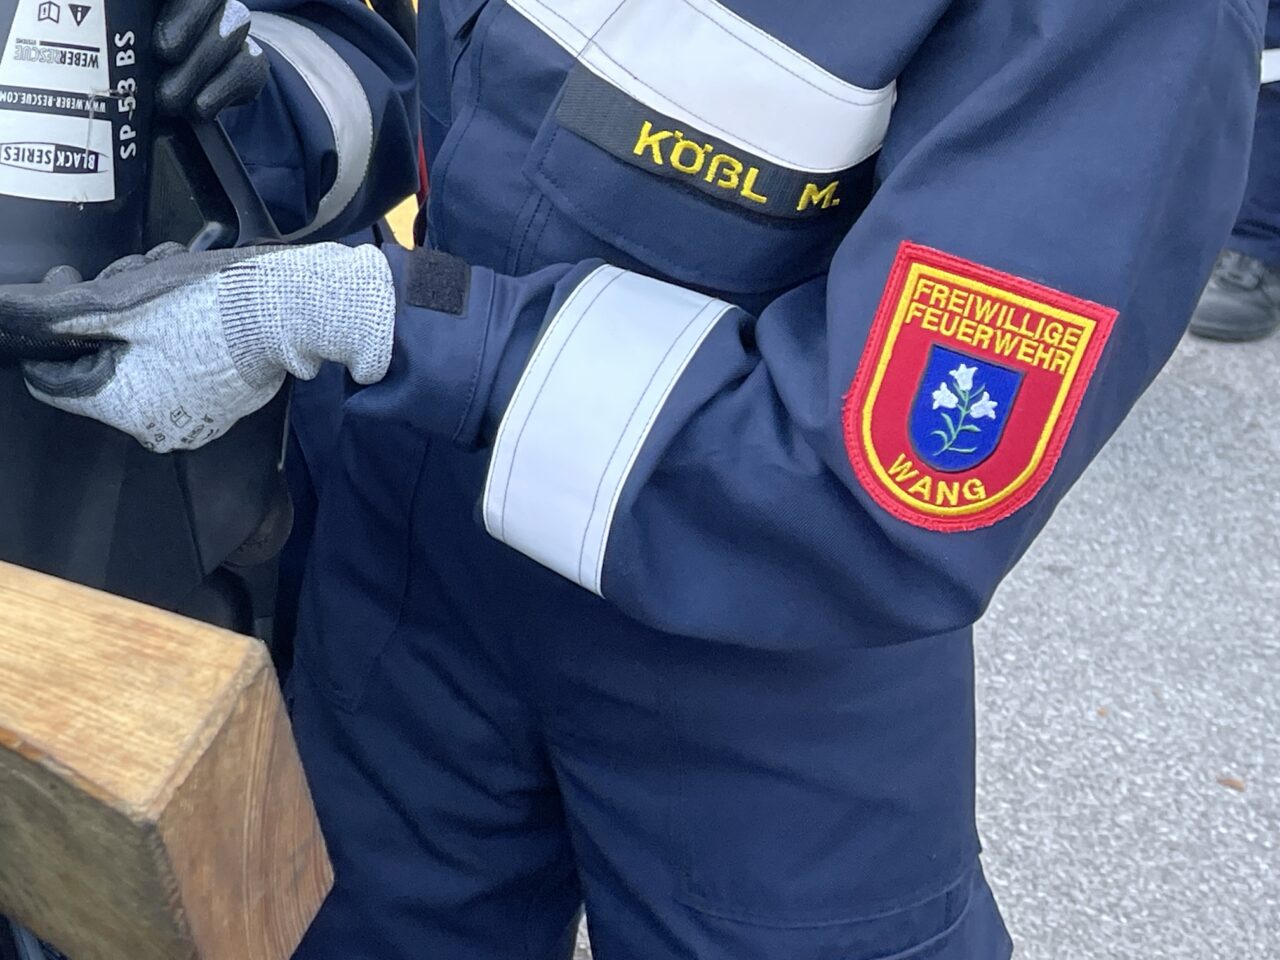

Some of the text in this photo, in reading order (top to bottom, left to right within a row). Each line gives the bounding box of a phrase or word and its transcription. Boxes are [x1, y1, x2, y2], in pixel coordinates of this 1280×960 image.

[115, 30, 136, 159] SP 53 BS
[3, 145, 96, 170] BLACK SERIES
[796, 180, 840, 212] M.
[905, 303, 1072, 375] FEUERWEHR
[913, 278, 1084, 351] FREIWILLIGE
[888, 453, 987, 506] WANG
